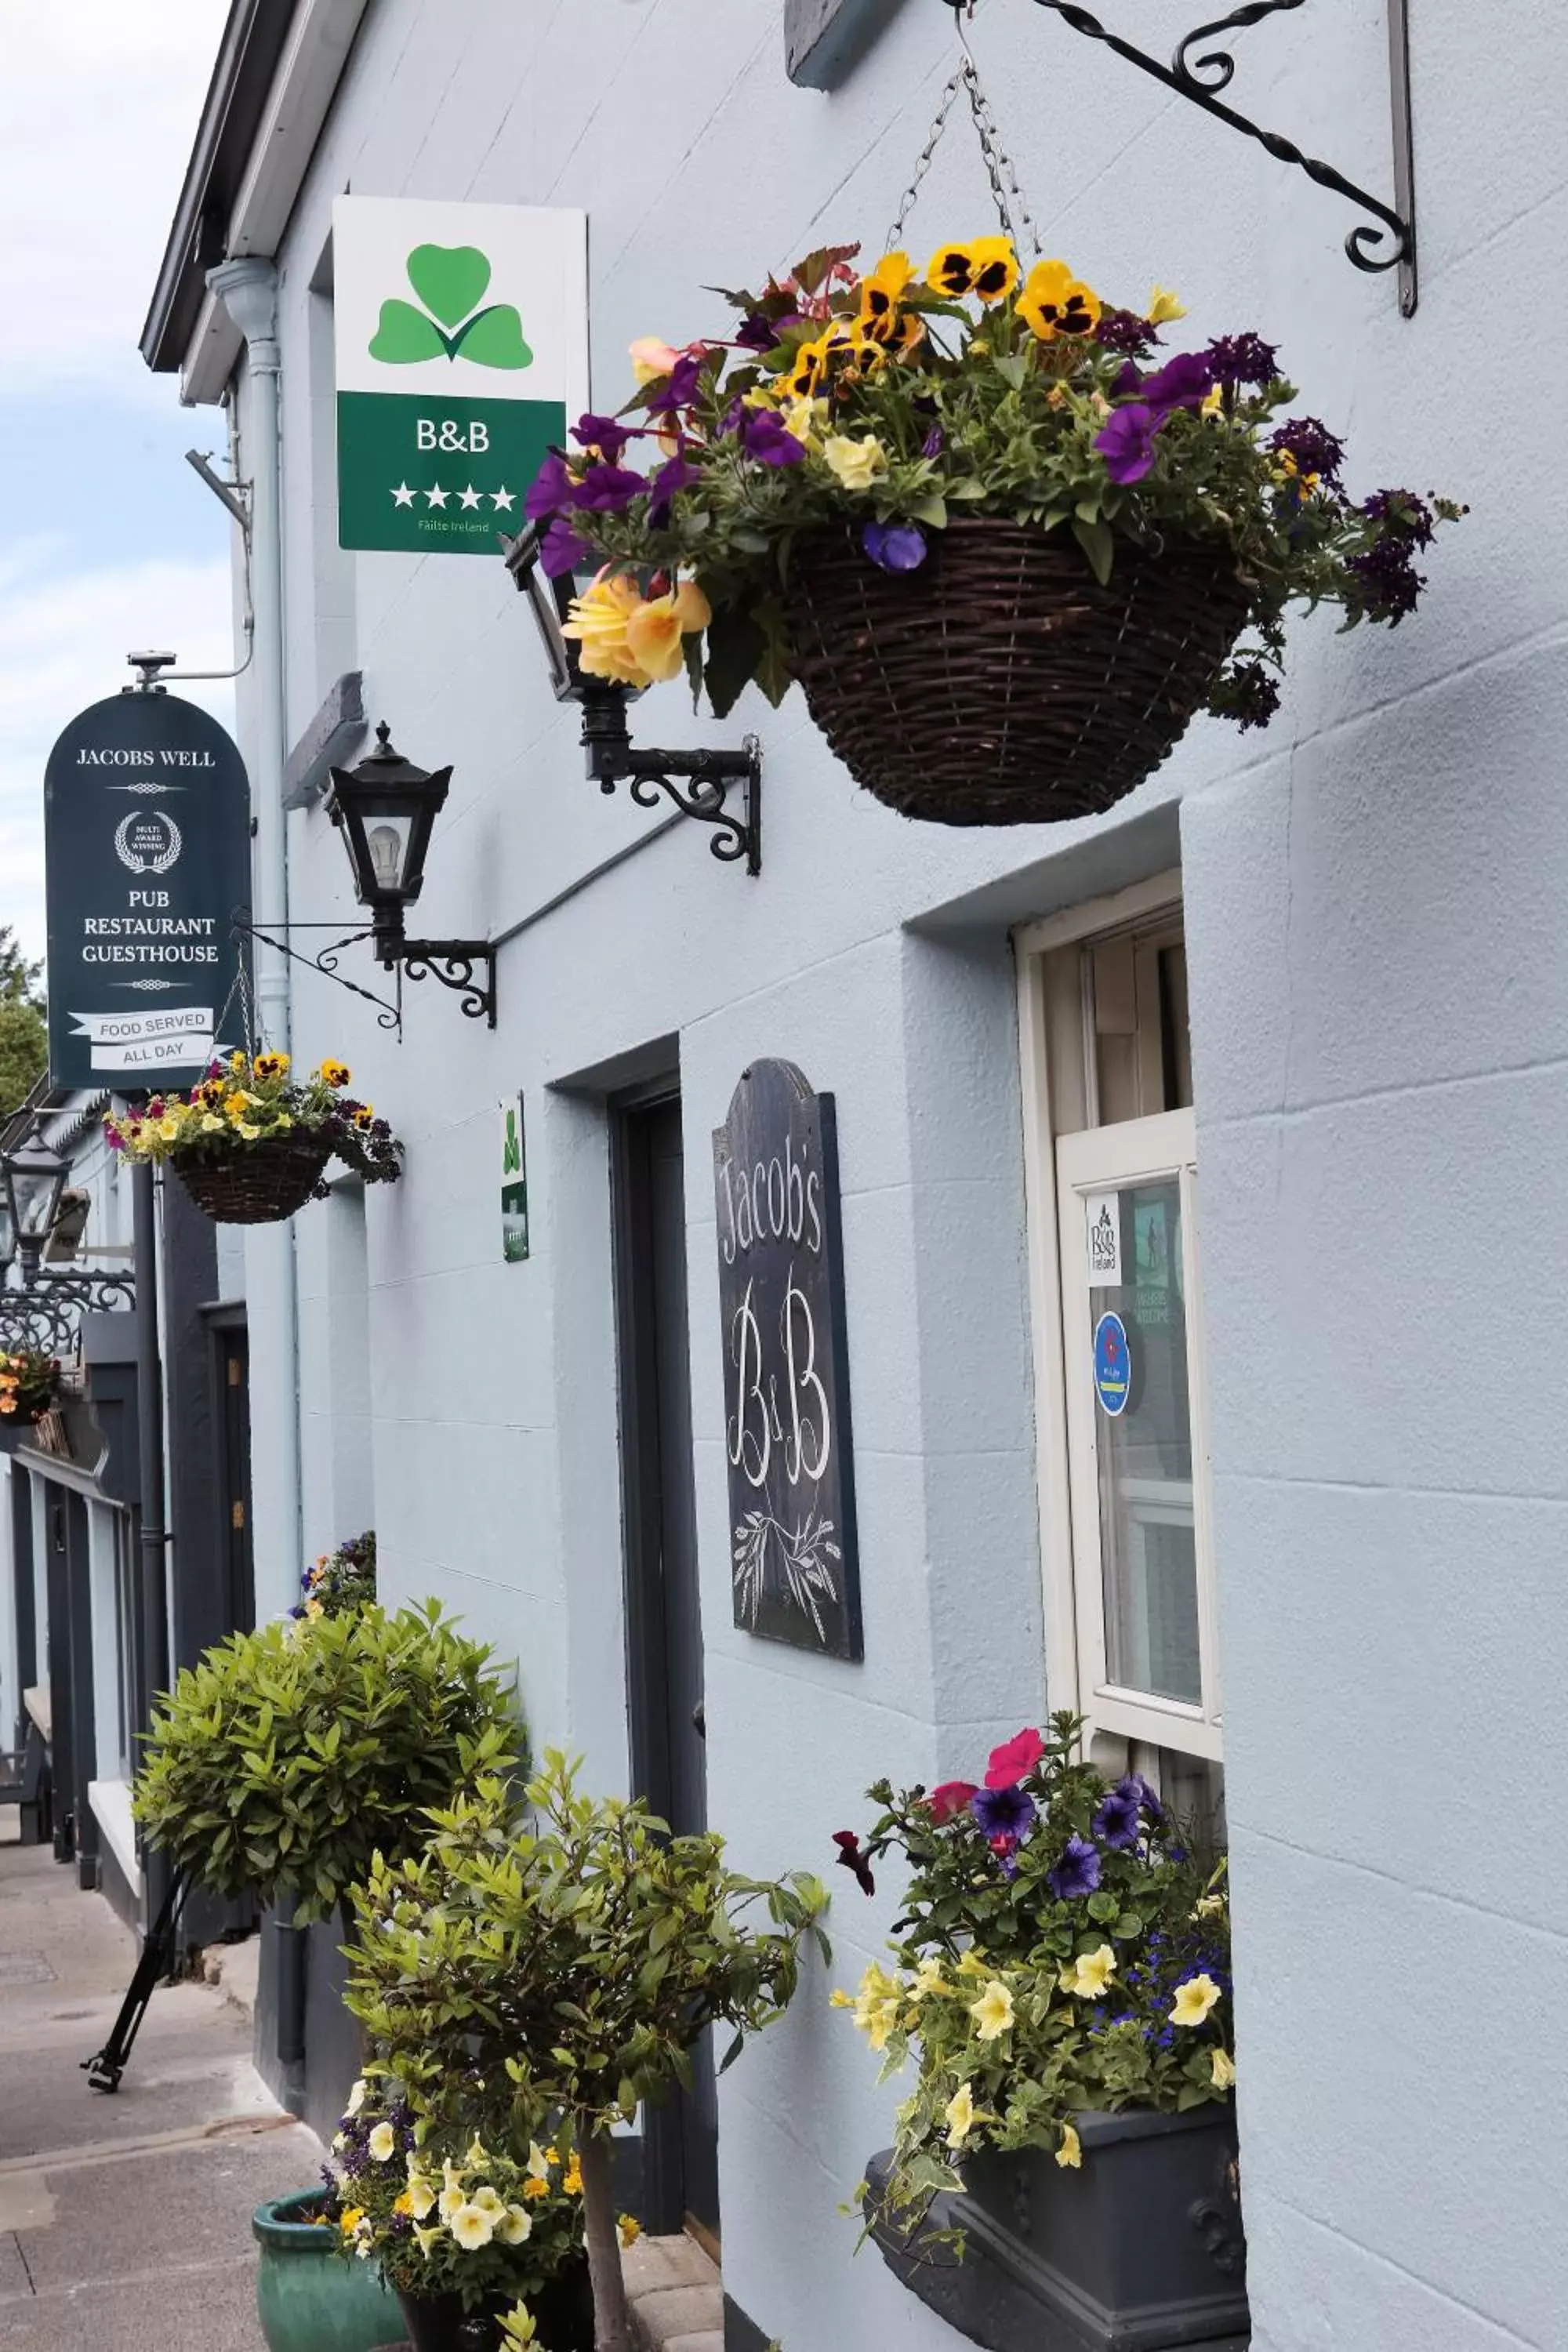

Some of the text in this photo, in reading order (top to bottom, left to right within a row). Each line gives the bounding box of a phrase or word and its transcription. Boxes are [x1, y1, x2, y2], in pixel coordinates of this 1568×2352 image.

[416, 419, 490, 452] B&B
[76, 749, 216, 768] JACOBS WELL
[129, 891, 170, 907] PUB
[84, 918, 216, 935] RESTAURANT
[82, 946, 219, 963] GUESTHOUSE
[100, 1013, 205, 1036] FOOD SERVED
[123, 1043, 183, 1064] ALL DAY
